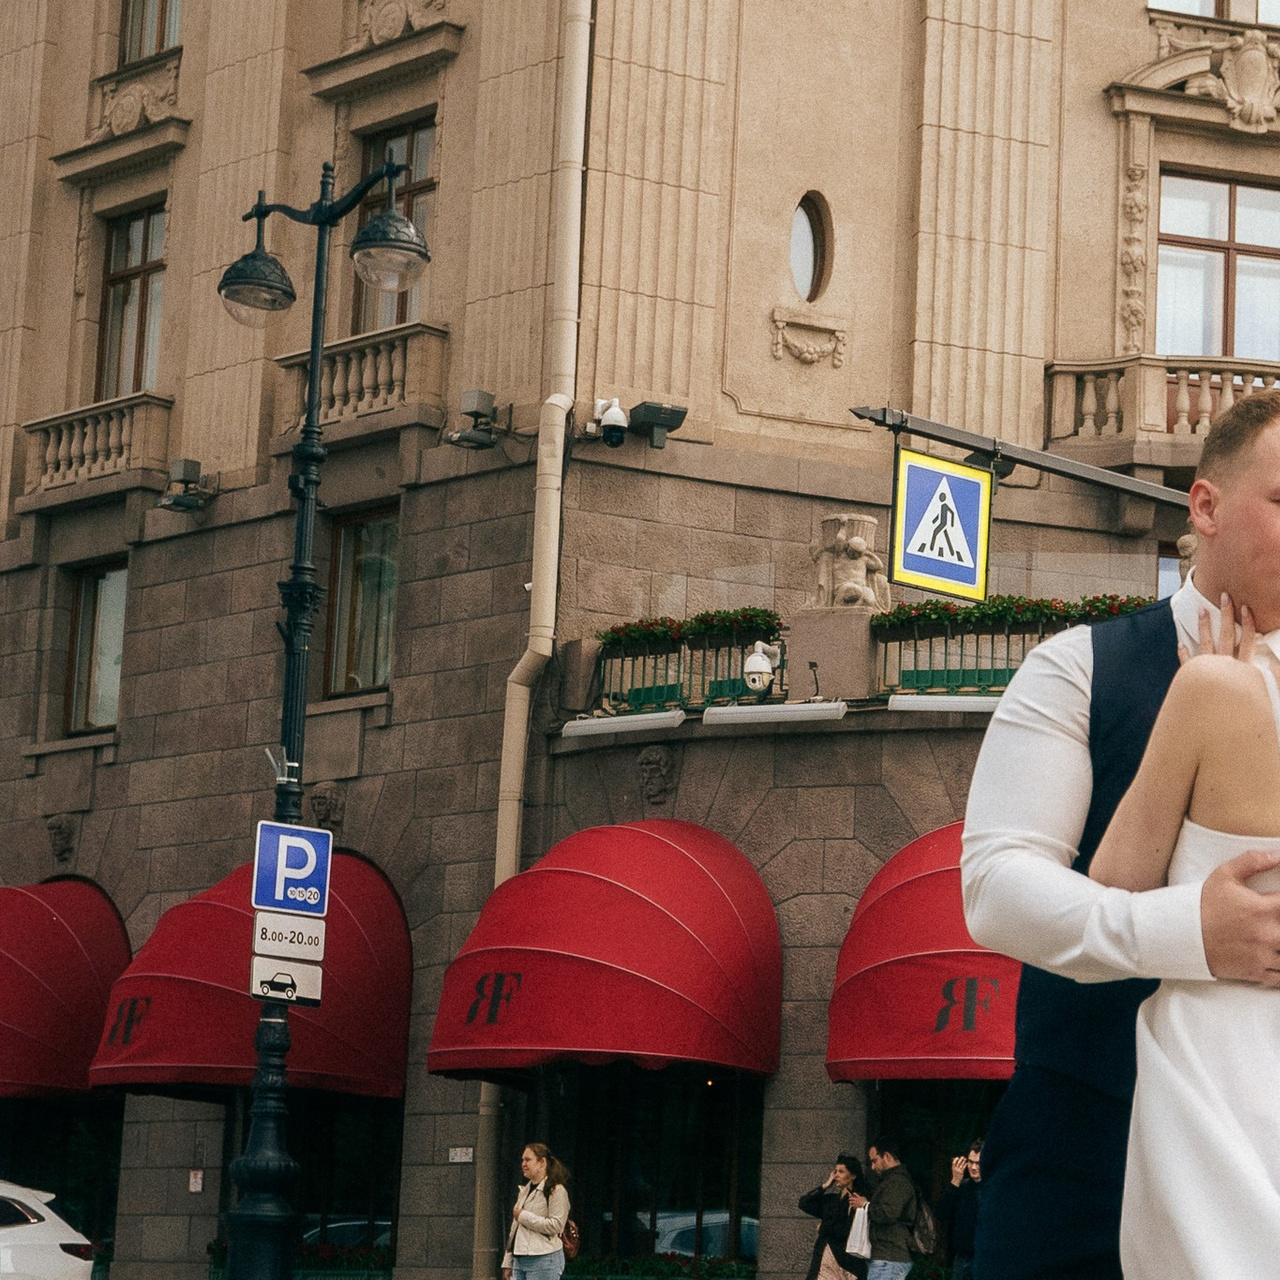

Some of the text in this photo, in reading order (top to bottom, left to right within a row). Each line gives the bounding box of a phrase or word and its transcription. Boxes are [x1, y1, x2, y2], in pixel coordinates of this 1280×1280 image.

[275, 835, 317, 900] P
[297, 890, 305, 898] 15
[307, 890, 319, 900] 20
[260, 927, 320, 947] 8.00-20.00
